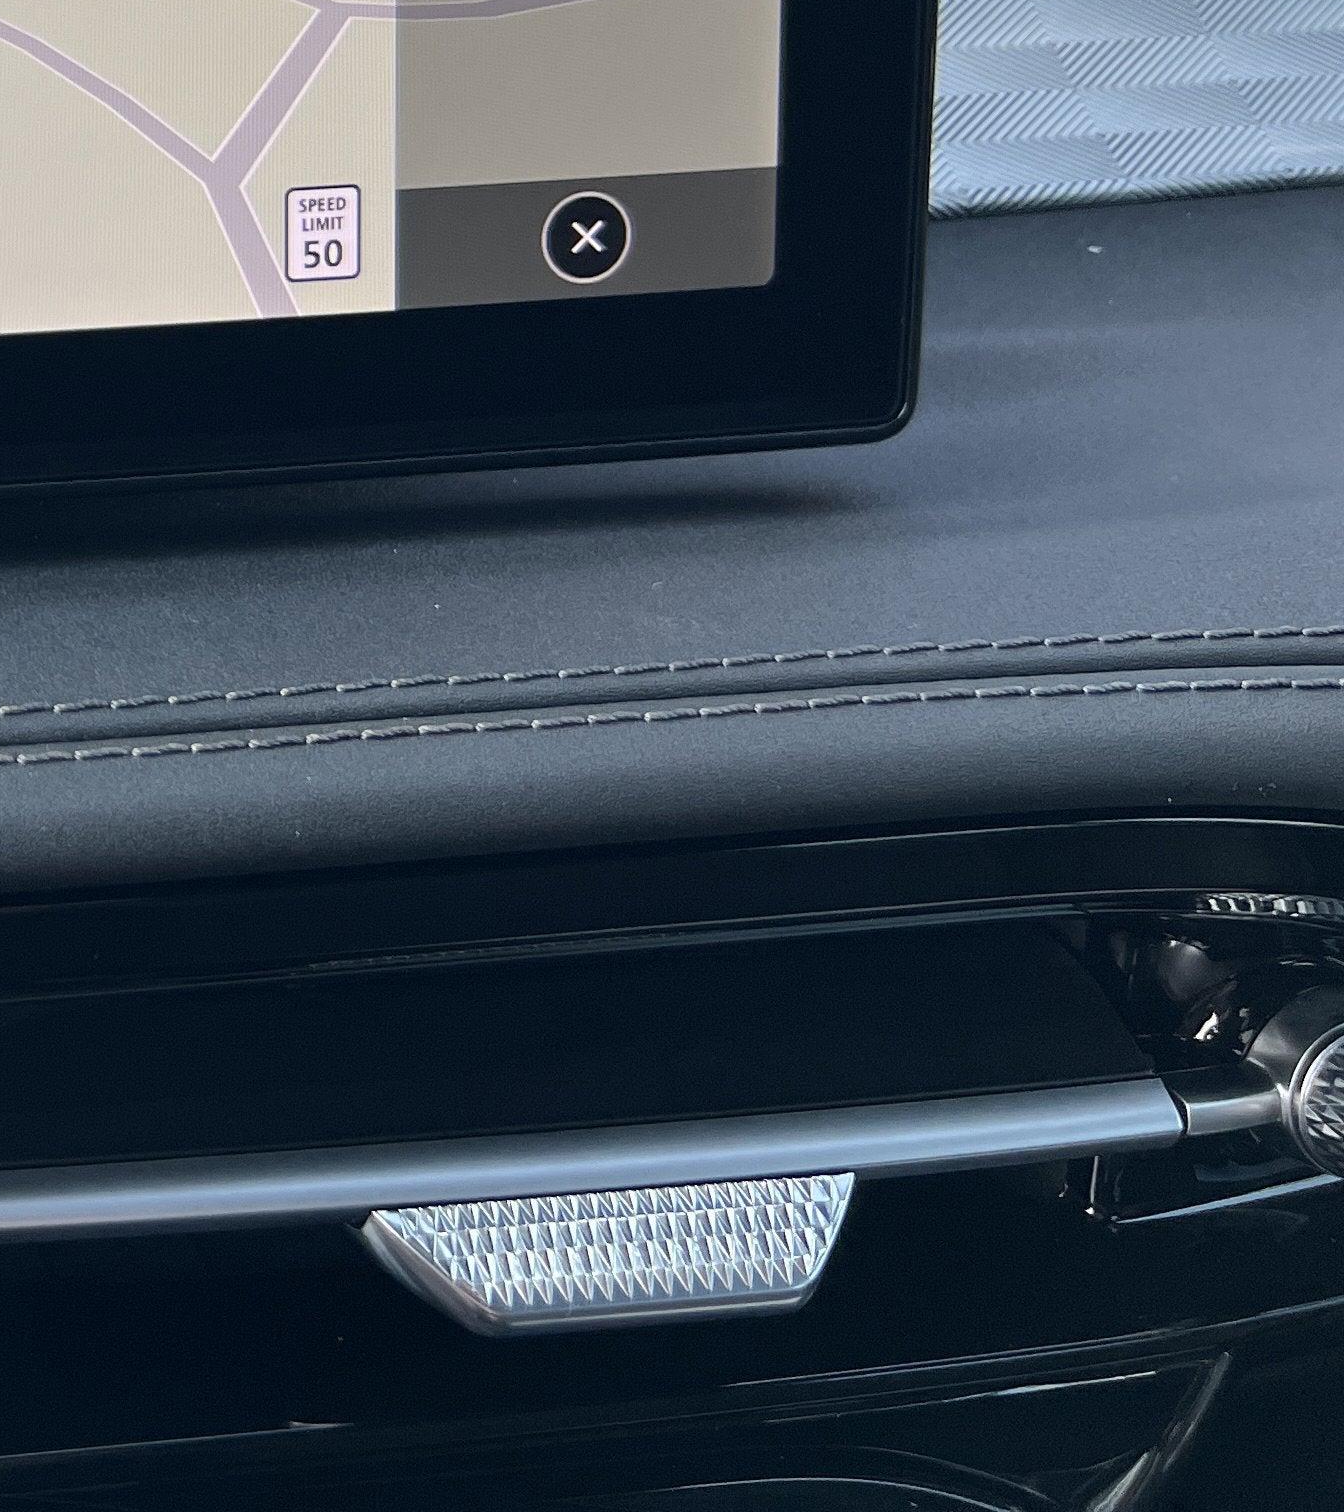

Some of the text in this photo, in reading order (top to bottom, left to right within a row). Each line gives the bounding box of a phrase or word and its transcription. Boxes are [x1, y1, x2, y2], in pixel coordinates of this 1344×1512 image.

[298, 197, 346, 213] SPEED
[302, 216, 343, 232] LIMIT
[304, 239, 343, 268] 50
